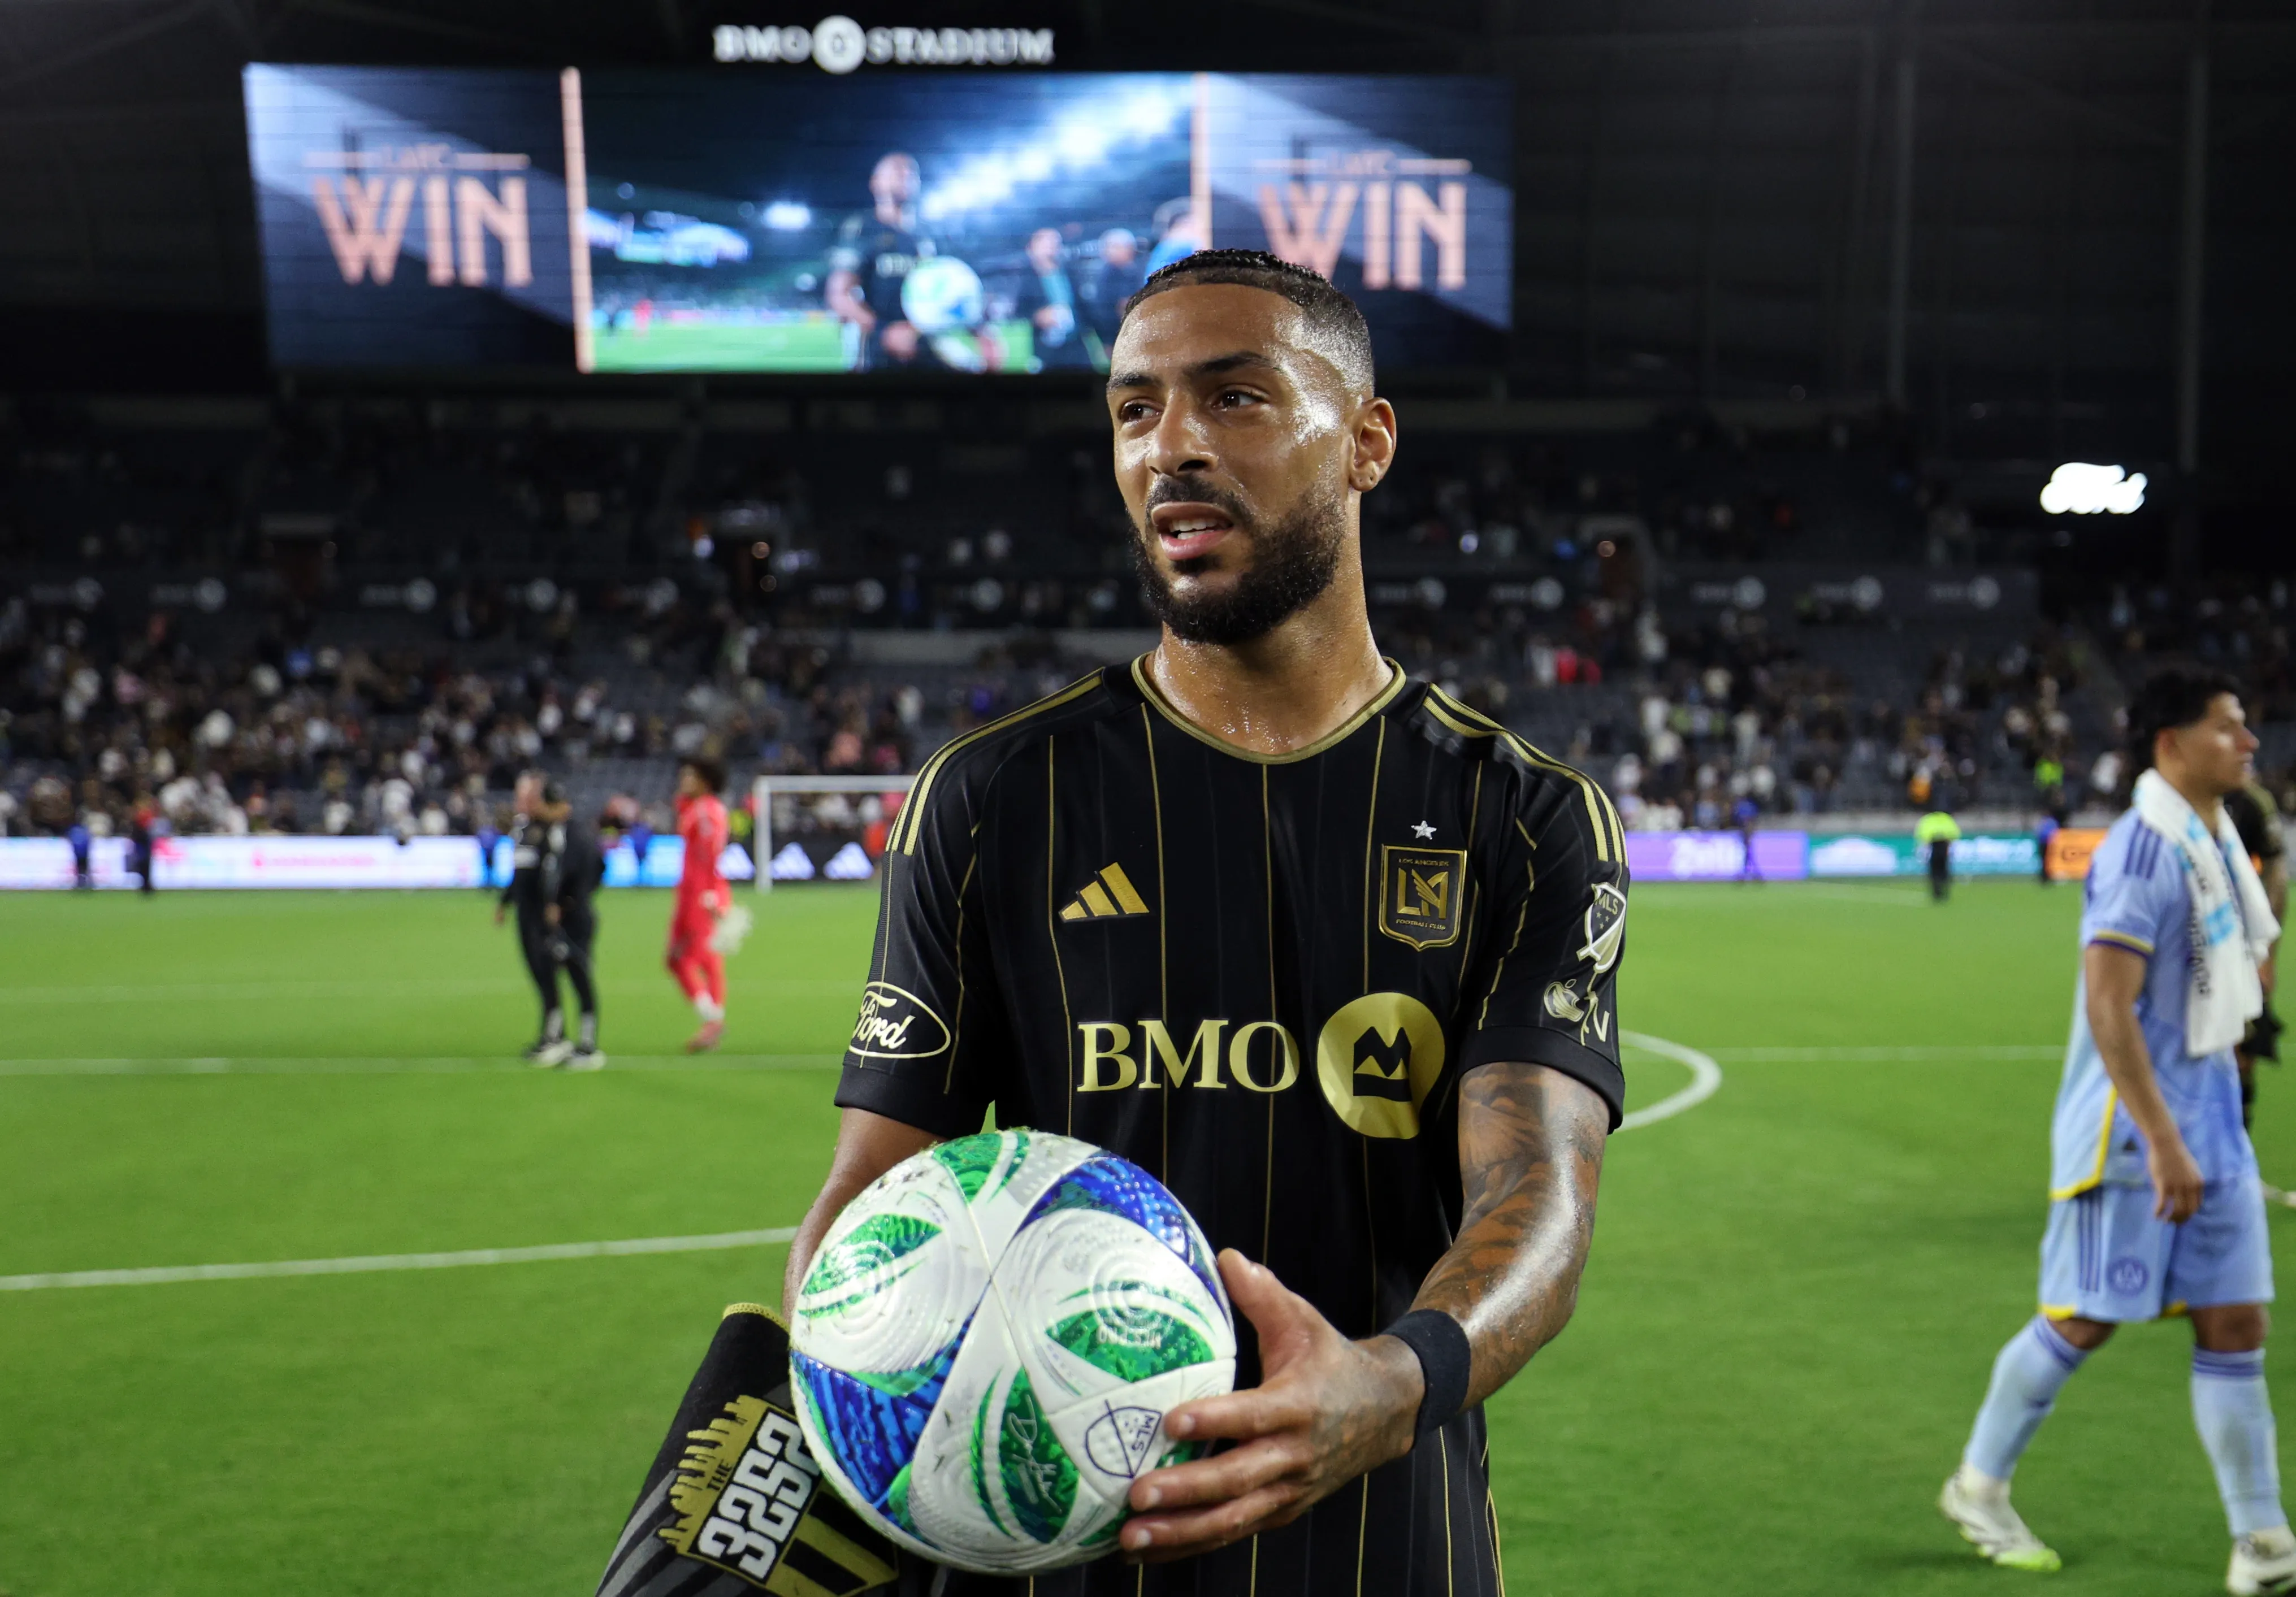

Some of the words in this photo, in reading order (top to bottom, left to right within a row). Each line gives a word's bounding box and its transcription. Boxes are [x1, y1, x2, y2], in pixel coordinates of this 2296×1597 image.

[713, 24, 813, 63] BMO
[865, 26, 1055, 64] STADIUM
[312, 176, 533, 287] WIN
[1259, 181, 1467, 291] WIN
[1594, 892, 1619, 915] MLS
[852, 991, 916, 1049] Ford
[1077, 1019, 1300, 1093] BMO
[1131, 1414, 1155, 1451] MLS
[698, 1412, 821, 1581] 3252
[707, 1459, 733, 1491] THE
